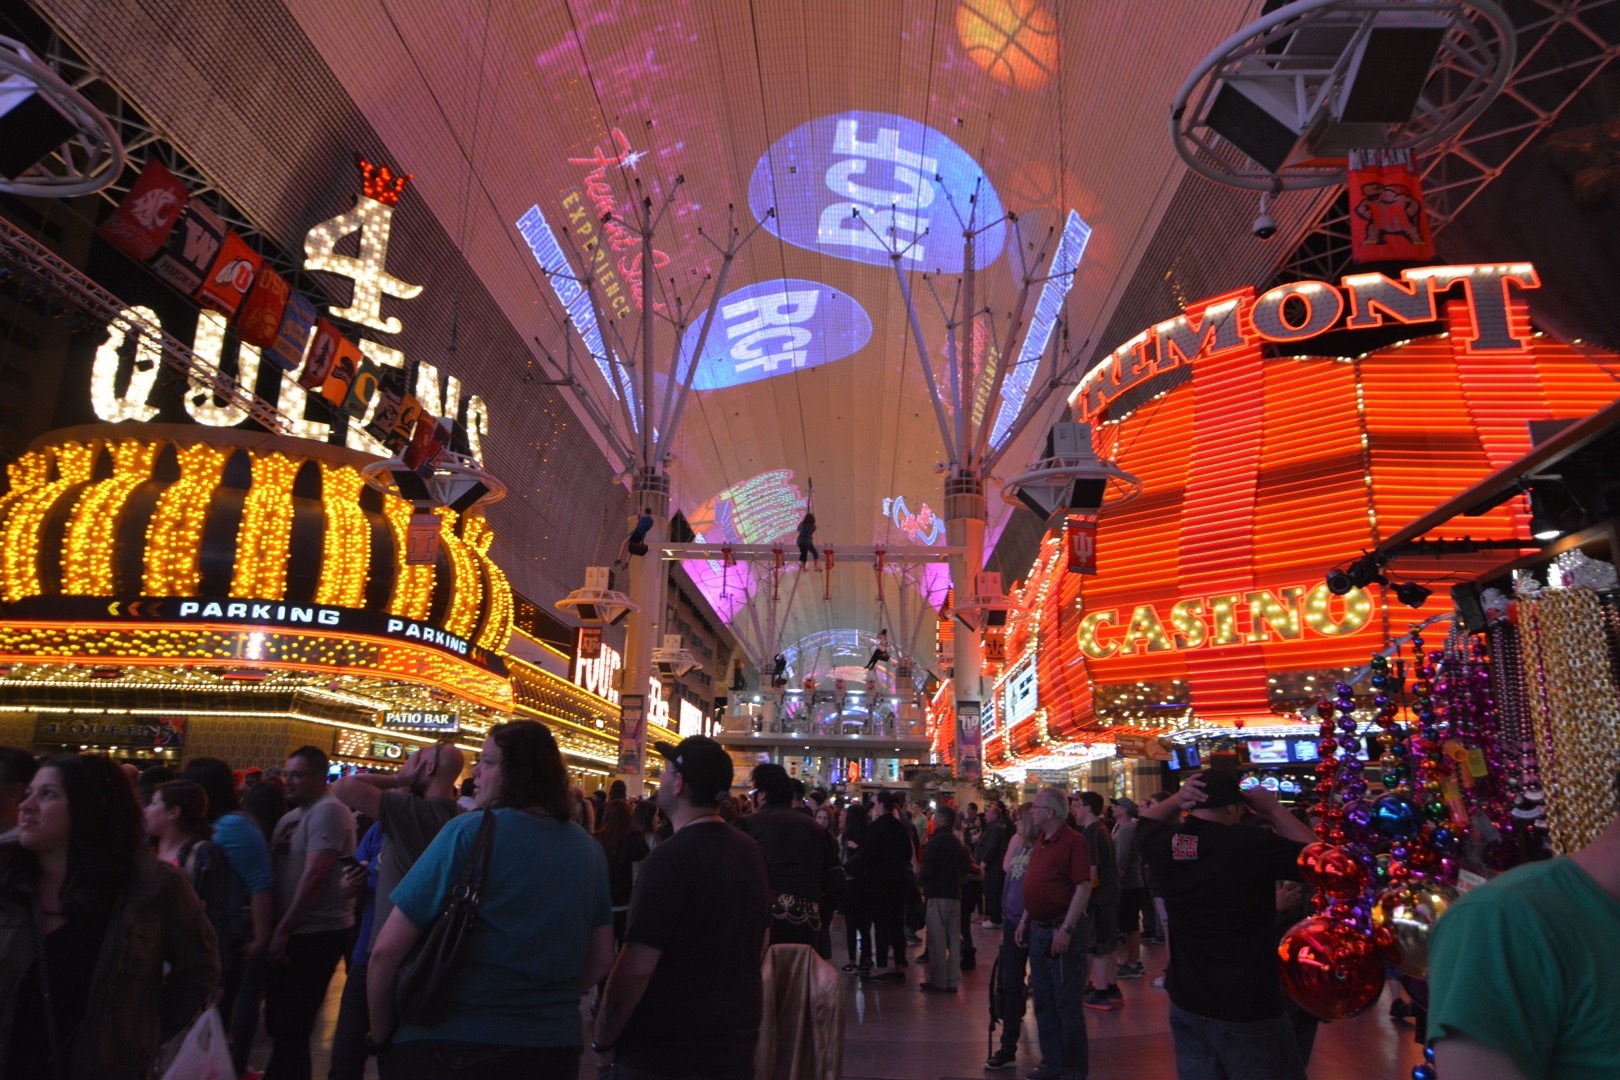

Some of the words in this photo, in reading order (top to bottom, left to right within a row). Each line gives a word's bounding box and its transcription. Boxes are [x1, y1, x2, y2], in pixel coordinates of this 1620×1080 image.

[816, 118, 938, 262] RCF
[182, 216, 220, 271] W
[304, 195, 424, 334] 4
[515, 203, 568, 277] PROUDLY
[562, 191, 630, 319] EXPERIENCE
[550, 262, 583, 307] USES
[566, 289, 598, 335] RCF
[721, 288, 820, 374] RCF
[1067, 263, 1541, 423] FREMONT
[179, 601, 340, 626] PARKING
[387, 618, 468, 655] PARKING
[1077, 582, 1376, 660] CASINO
[43, 721, 60, 735] 4
[64, 718, 178, 744] QUEENS
[386, 712, 422, 724] PATIO
[424, 713, 450, 725] BAR
